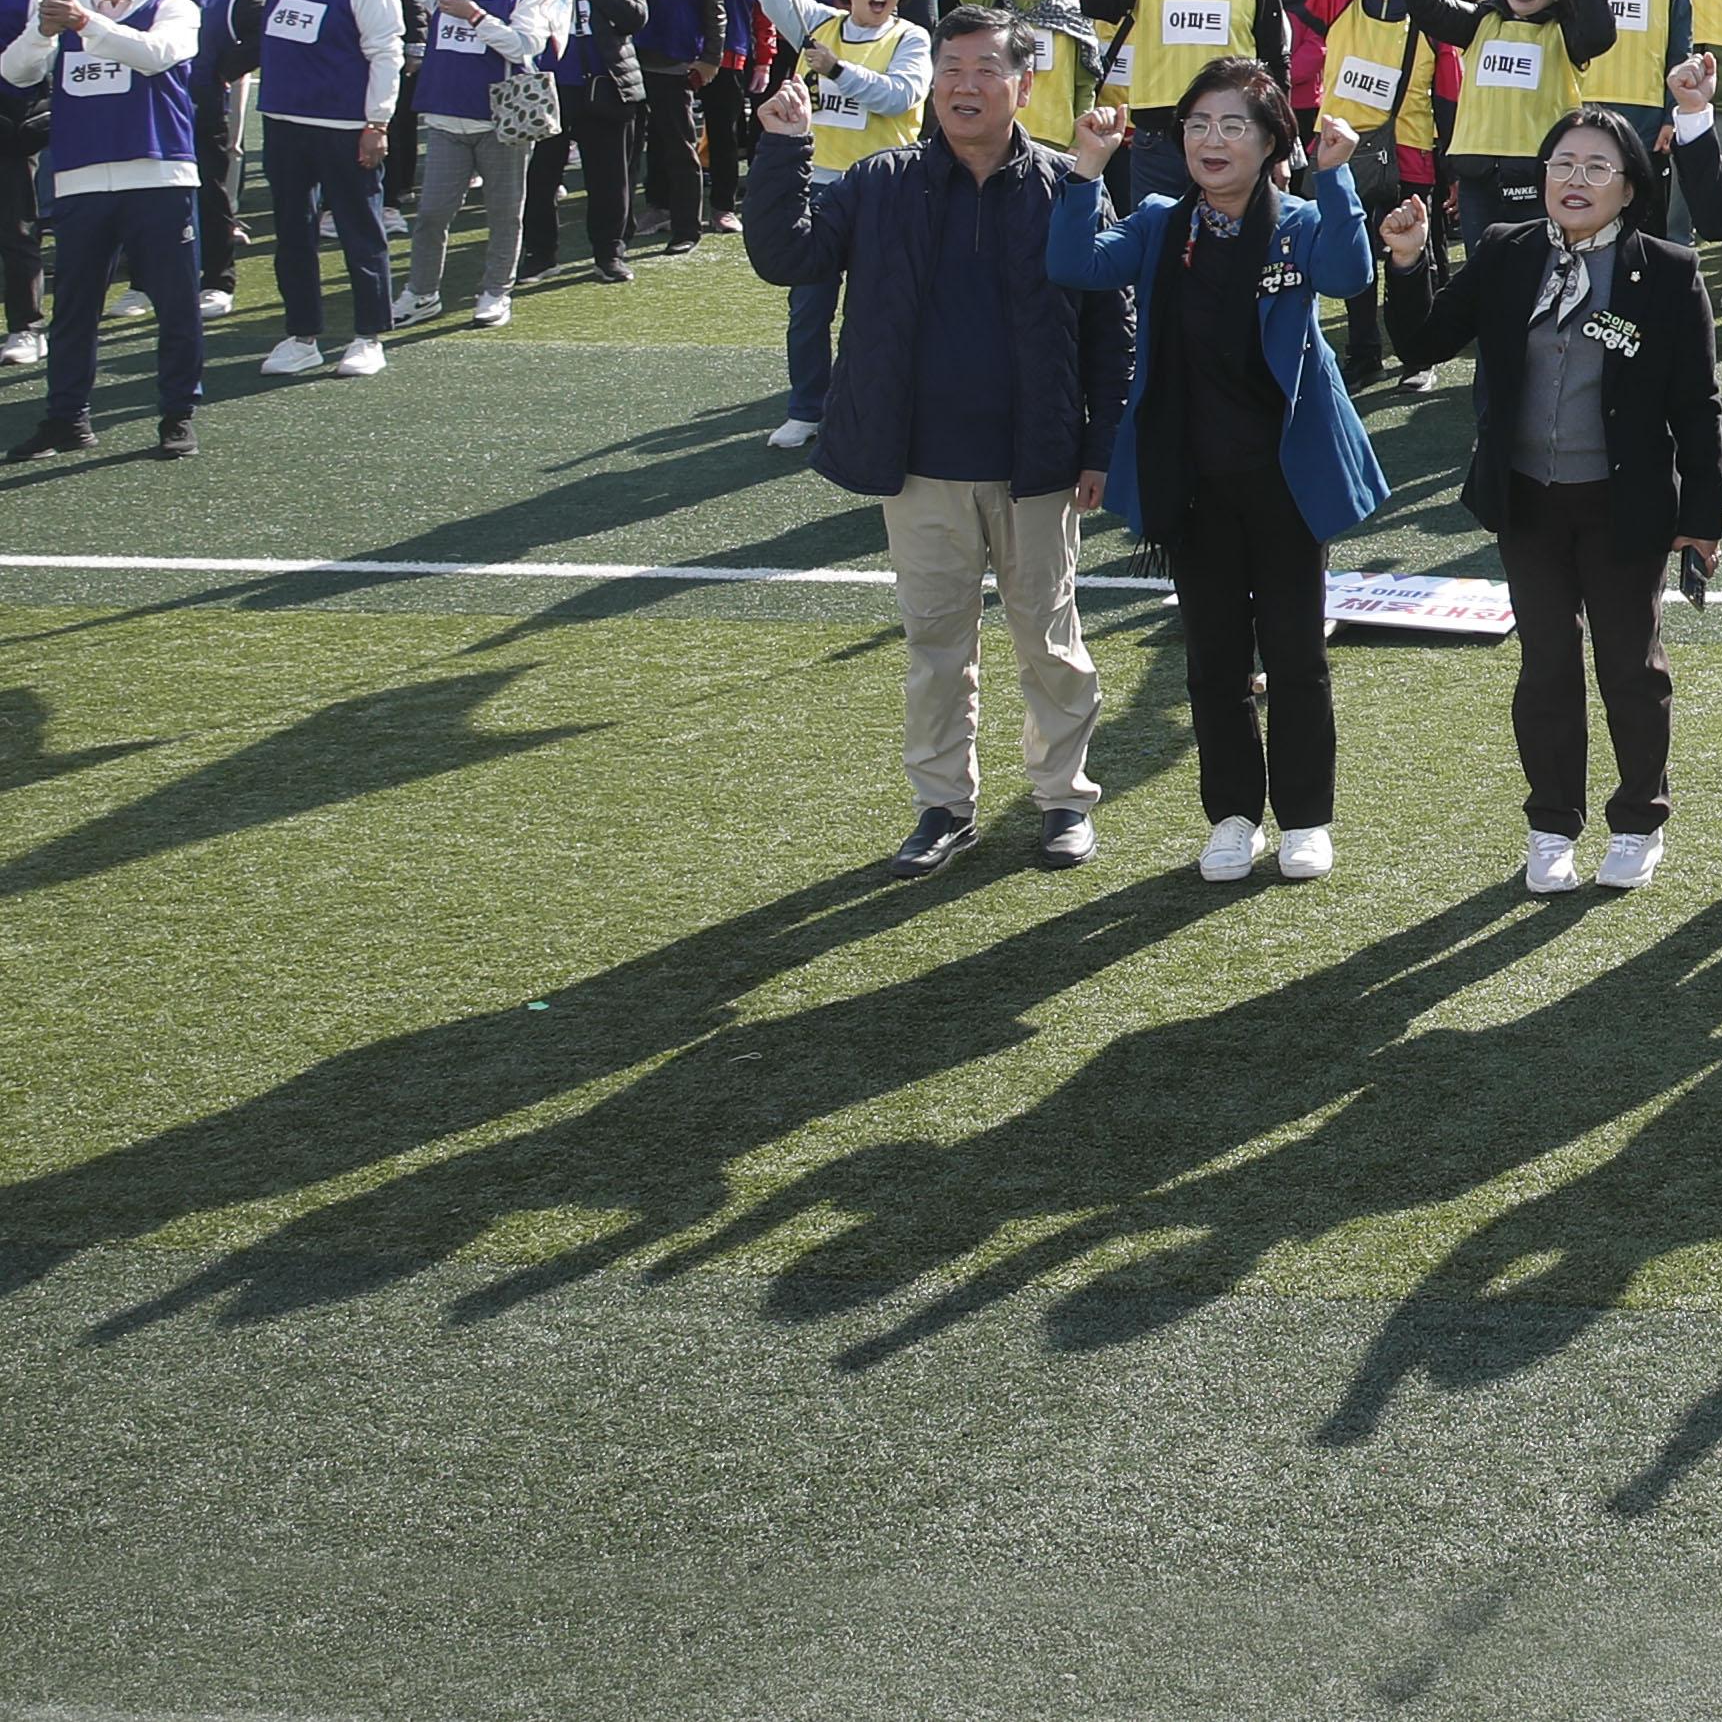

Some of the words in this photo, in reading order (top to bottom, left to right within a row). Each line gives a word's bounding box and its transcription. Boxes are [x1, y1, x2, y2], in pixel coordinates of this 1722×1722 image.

[273, 7, 313, 30] 성동구
[1170, 11, 1223, 31] 아파트
[1611, 0, 1641, 19] 파트
[70, 62, 122, 84] 성동구
[1483, 53, 1532, 76] 아파트
[1343, 68, 1390, 98] 아파트
[1256, 272, 1303, 300] 연희
[1599, 311, 1637, 336] 구의원
[1582, 321, 1641, 358] 이영심
